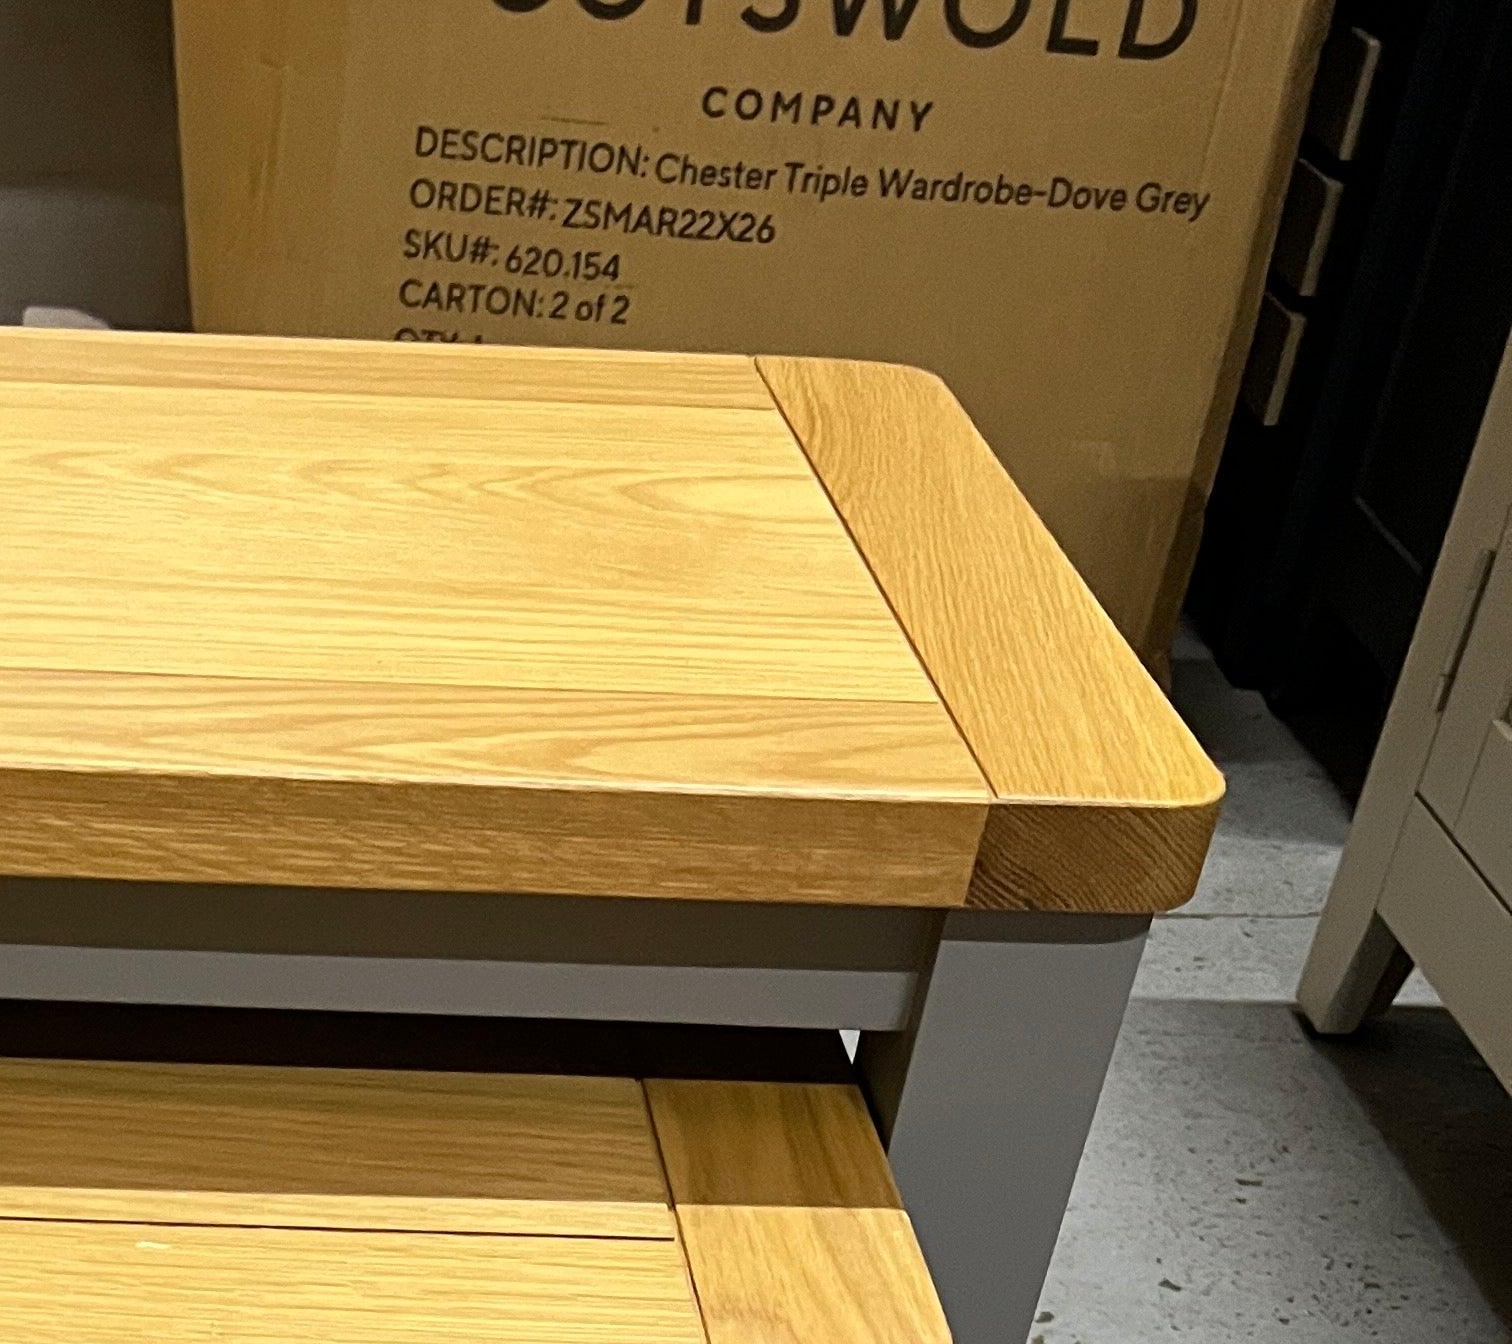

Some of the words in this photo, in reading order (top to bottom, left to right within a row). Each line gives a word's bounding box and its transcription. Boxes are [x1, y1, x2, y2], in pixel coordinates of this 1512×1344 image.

[701, 85, 934, 132] COMPANY
[414, 125, 651, 179] DESCRIPTION:
[654, 152, 779, 192] Chester
[785, 161, 869, 203] Triple
[878, 167, 1128, 212] Wardrobe-Dove
[1134, 182, 1211, 223] Grey
[409, 178, 558, 221] ORDER#:
[562, 198, 776, 244] ZSMAR22X26
[403, 229, 498, 267] SKU#:
[504, 244, 622, 282] 620.154
[398, 278, 543, 319] CARTON:
[548, 291, 569, 320] 2
[574, 294, 606, 323] of
[610, 295, 632, 325] 2
